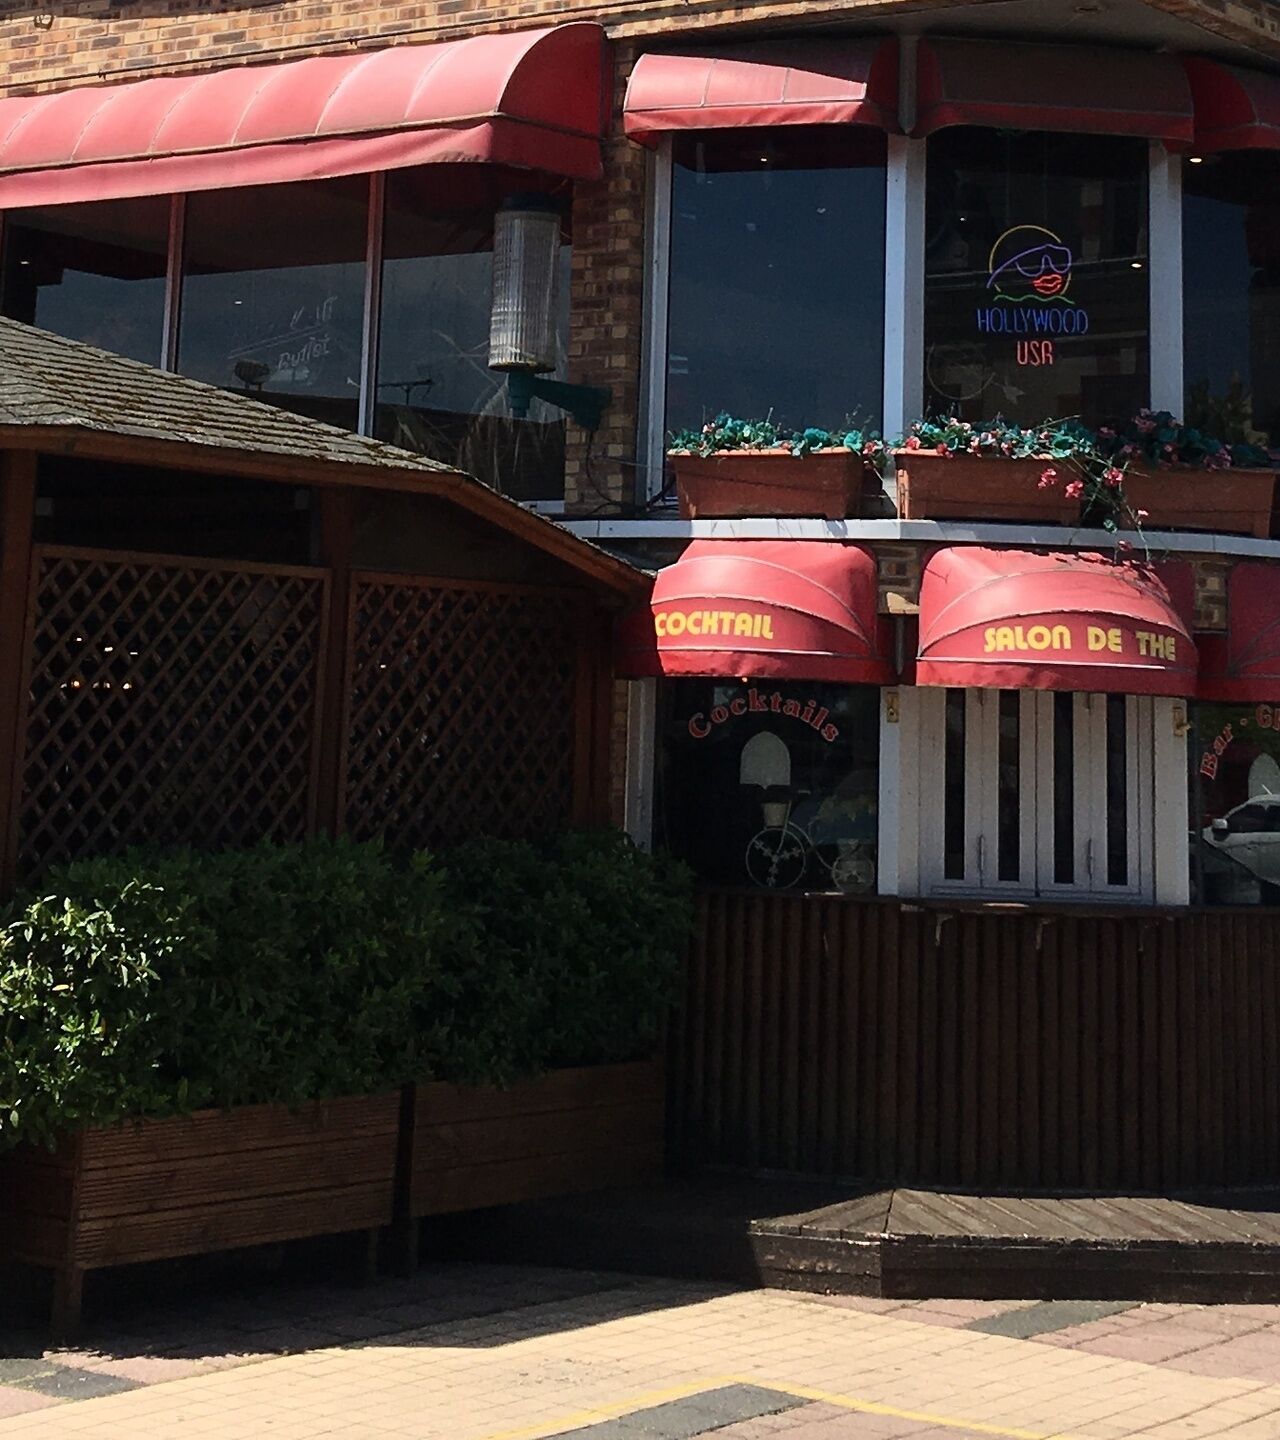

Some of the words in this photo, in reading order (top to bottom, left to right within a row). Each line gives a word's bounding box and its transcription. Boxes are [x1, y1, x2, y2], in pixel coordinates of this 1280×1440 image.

[977, 307, 1089, 334] HOLLYWOOD
[1016, 340, 1053, 366] USA
[654, 610, 774, 640] COCKTAIL
[984, 625, 1072, 653] SALON
[1086, 626, 1123, 653] DE
[1134, 630, 1177, 662] THE
[688, 687, 840, 742] Cocktails
[1200, 722, 1234, 781] Bar
